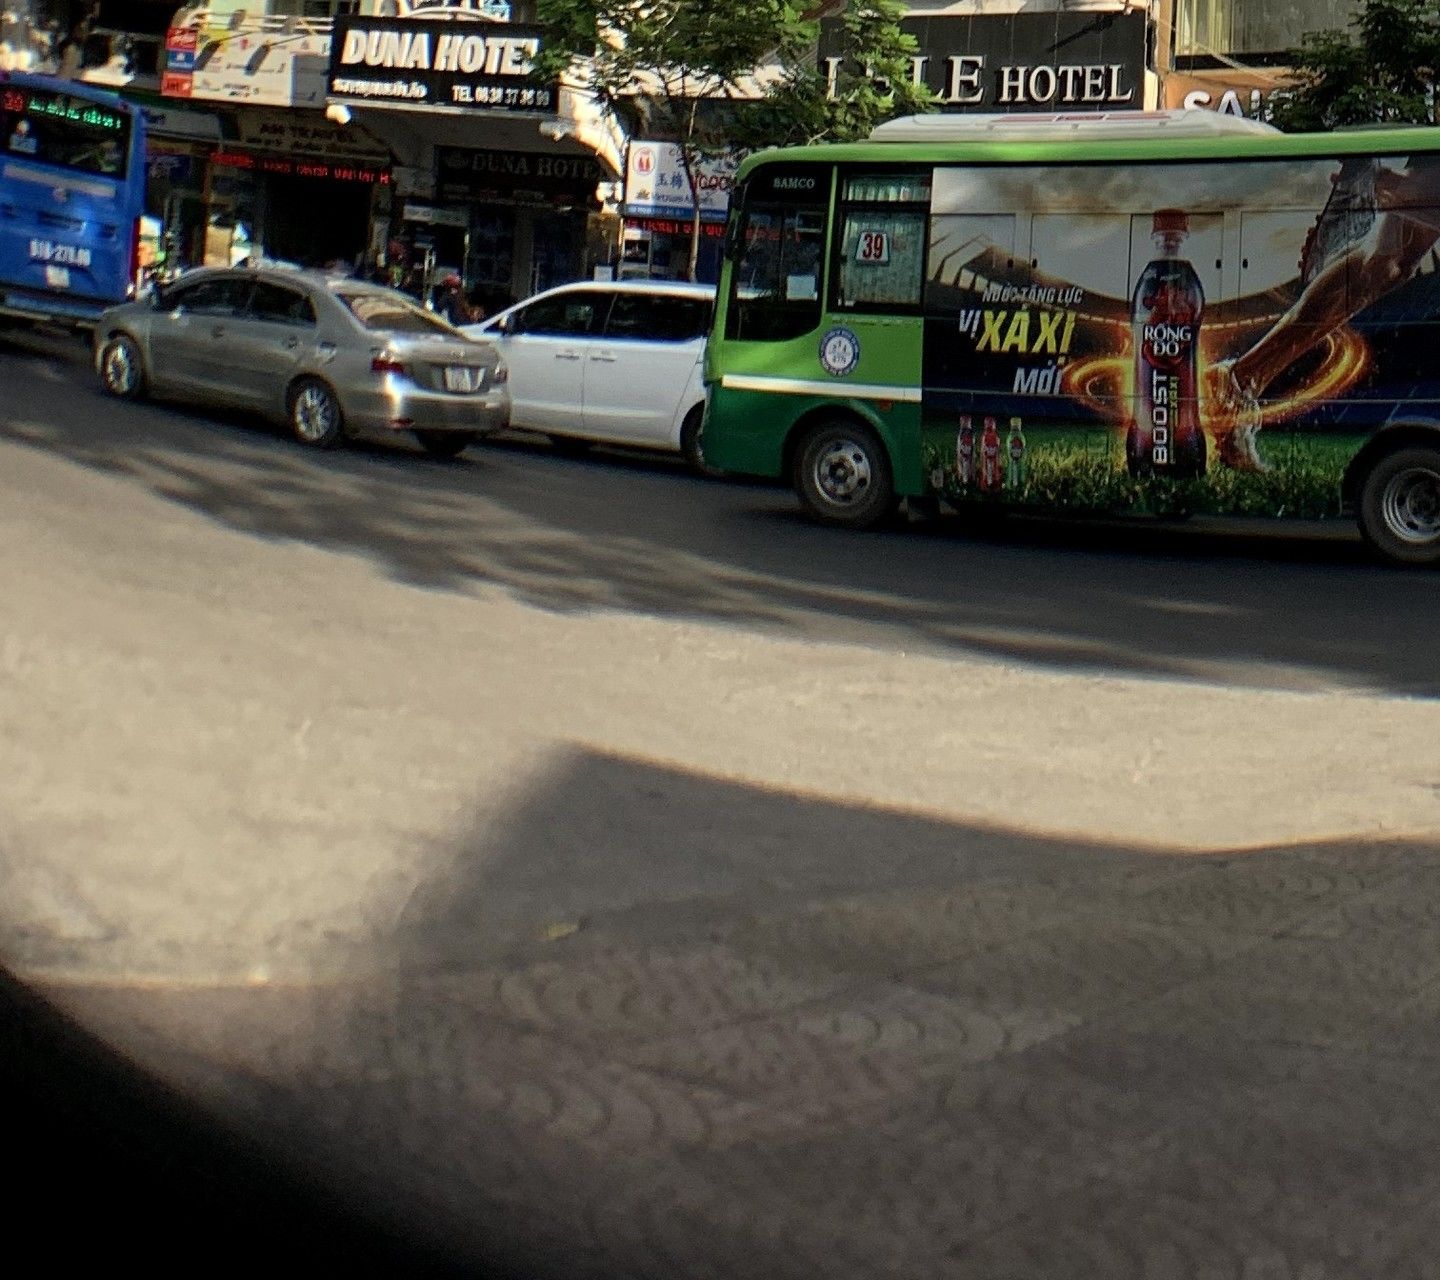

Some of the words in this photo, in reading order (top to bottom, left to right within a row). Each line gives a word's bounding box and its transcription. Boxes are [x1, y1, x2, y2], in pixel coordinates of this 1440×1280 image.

[340, 28, 430, 70] DUNA
[999, 63, 1133, 103] HOTEL
[536, 157, 606, 182] HOTE
[773, 176, 816, 190] SAMCO
[862, 232, 884, 260] 39
[1152, 368, 1168, 465] BOOST
